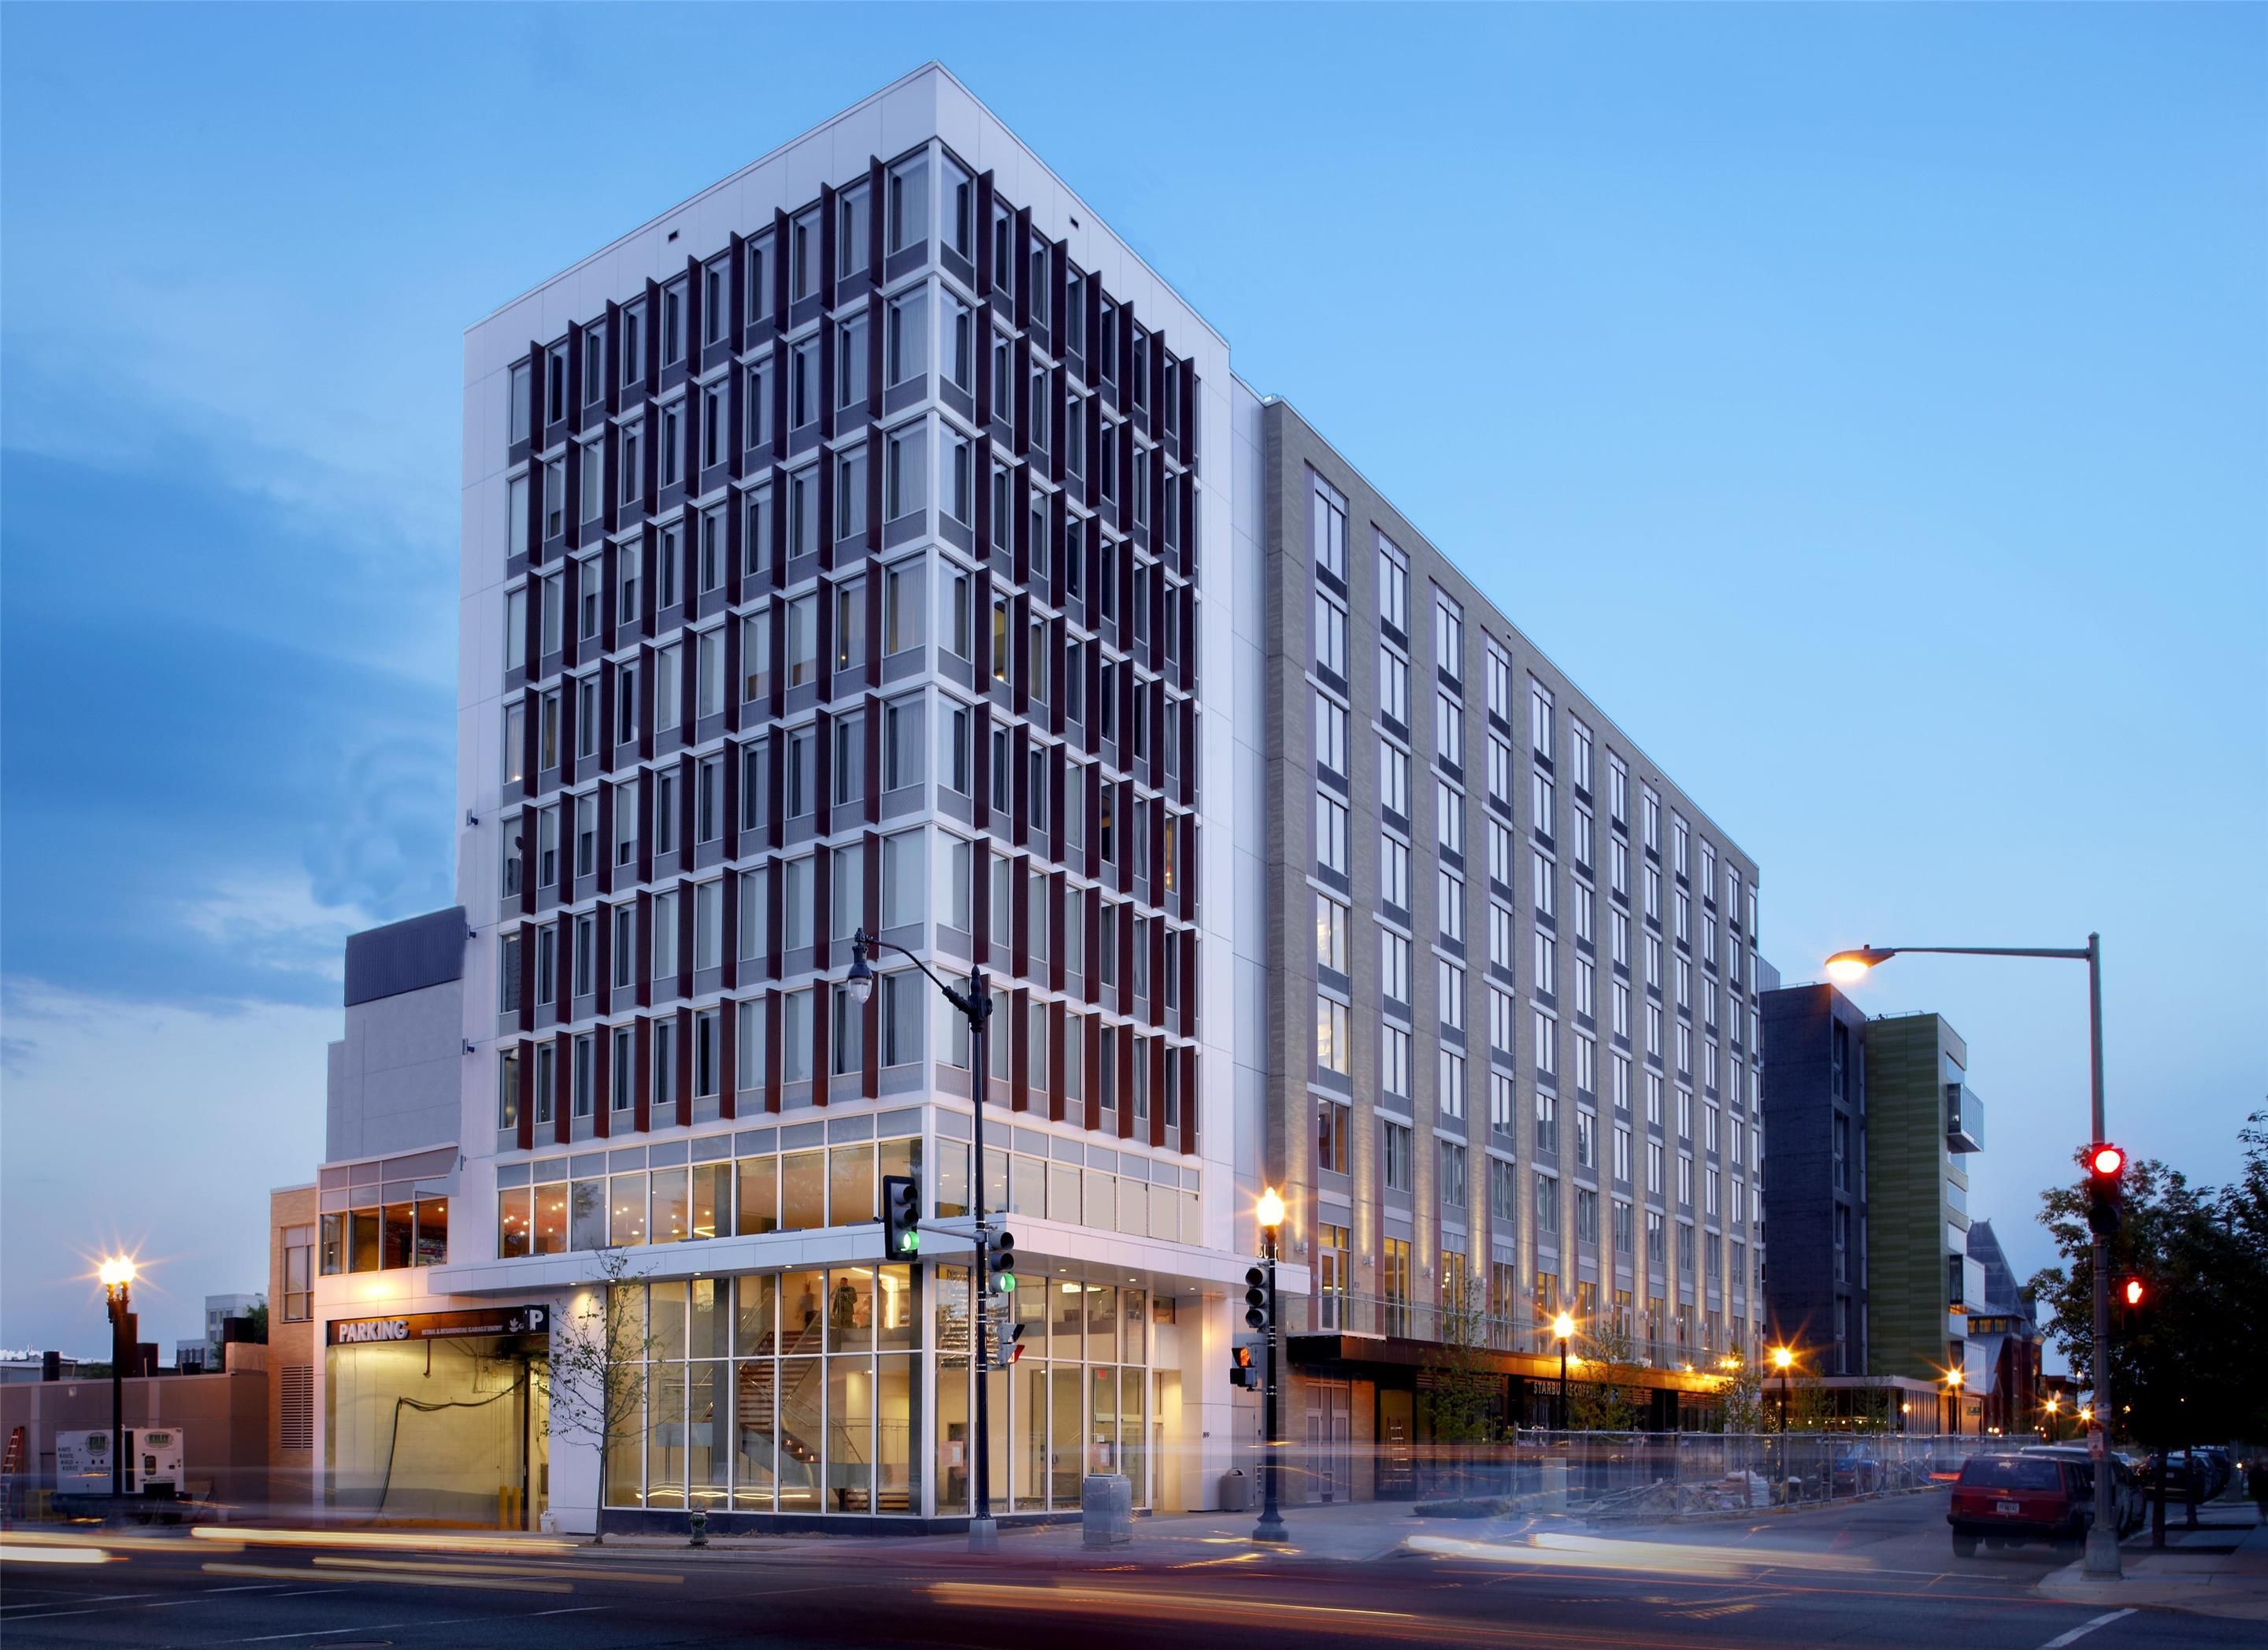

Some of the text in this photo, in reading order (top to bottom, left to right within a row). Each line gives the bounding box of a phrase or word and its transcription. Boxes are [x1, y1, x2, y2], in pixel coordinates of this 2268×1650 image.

[339, 1319, 410, 1343] PARKING
[529, 1309, 543, 1331] P
[1533, 1381, 1574, 1397] STARBUKS
